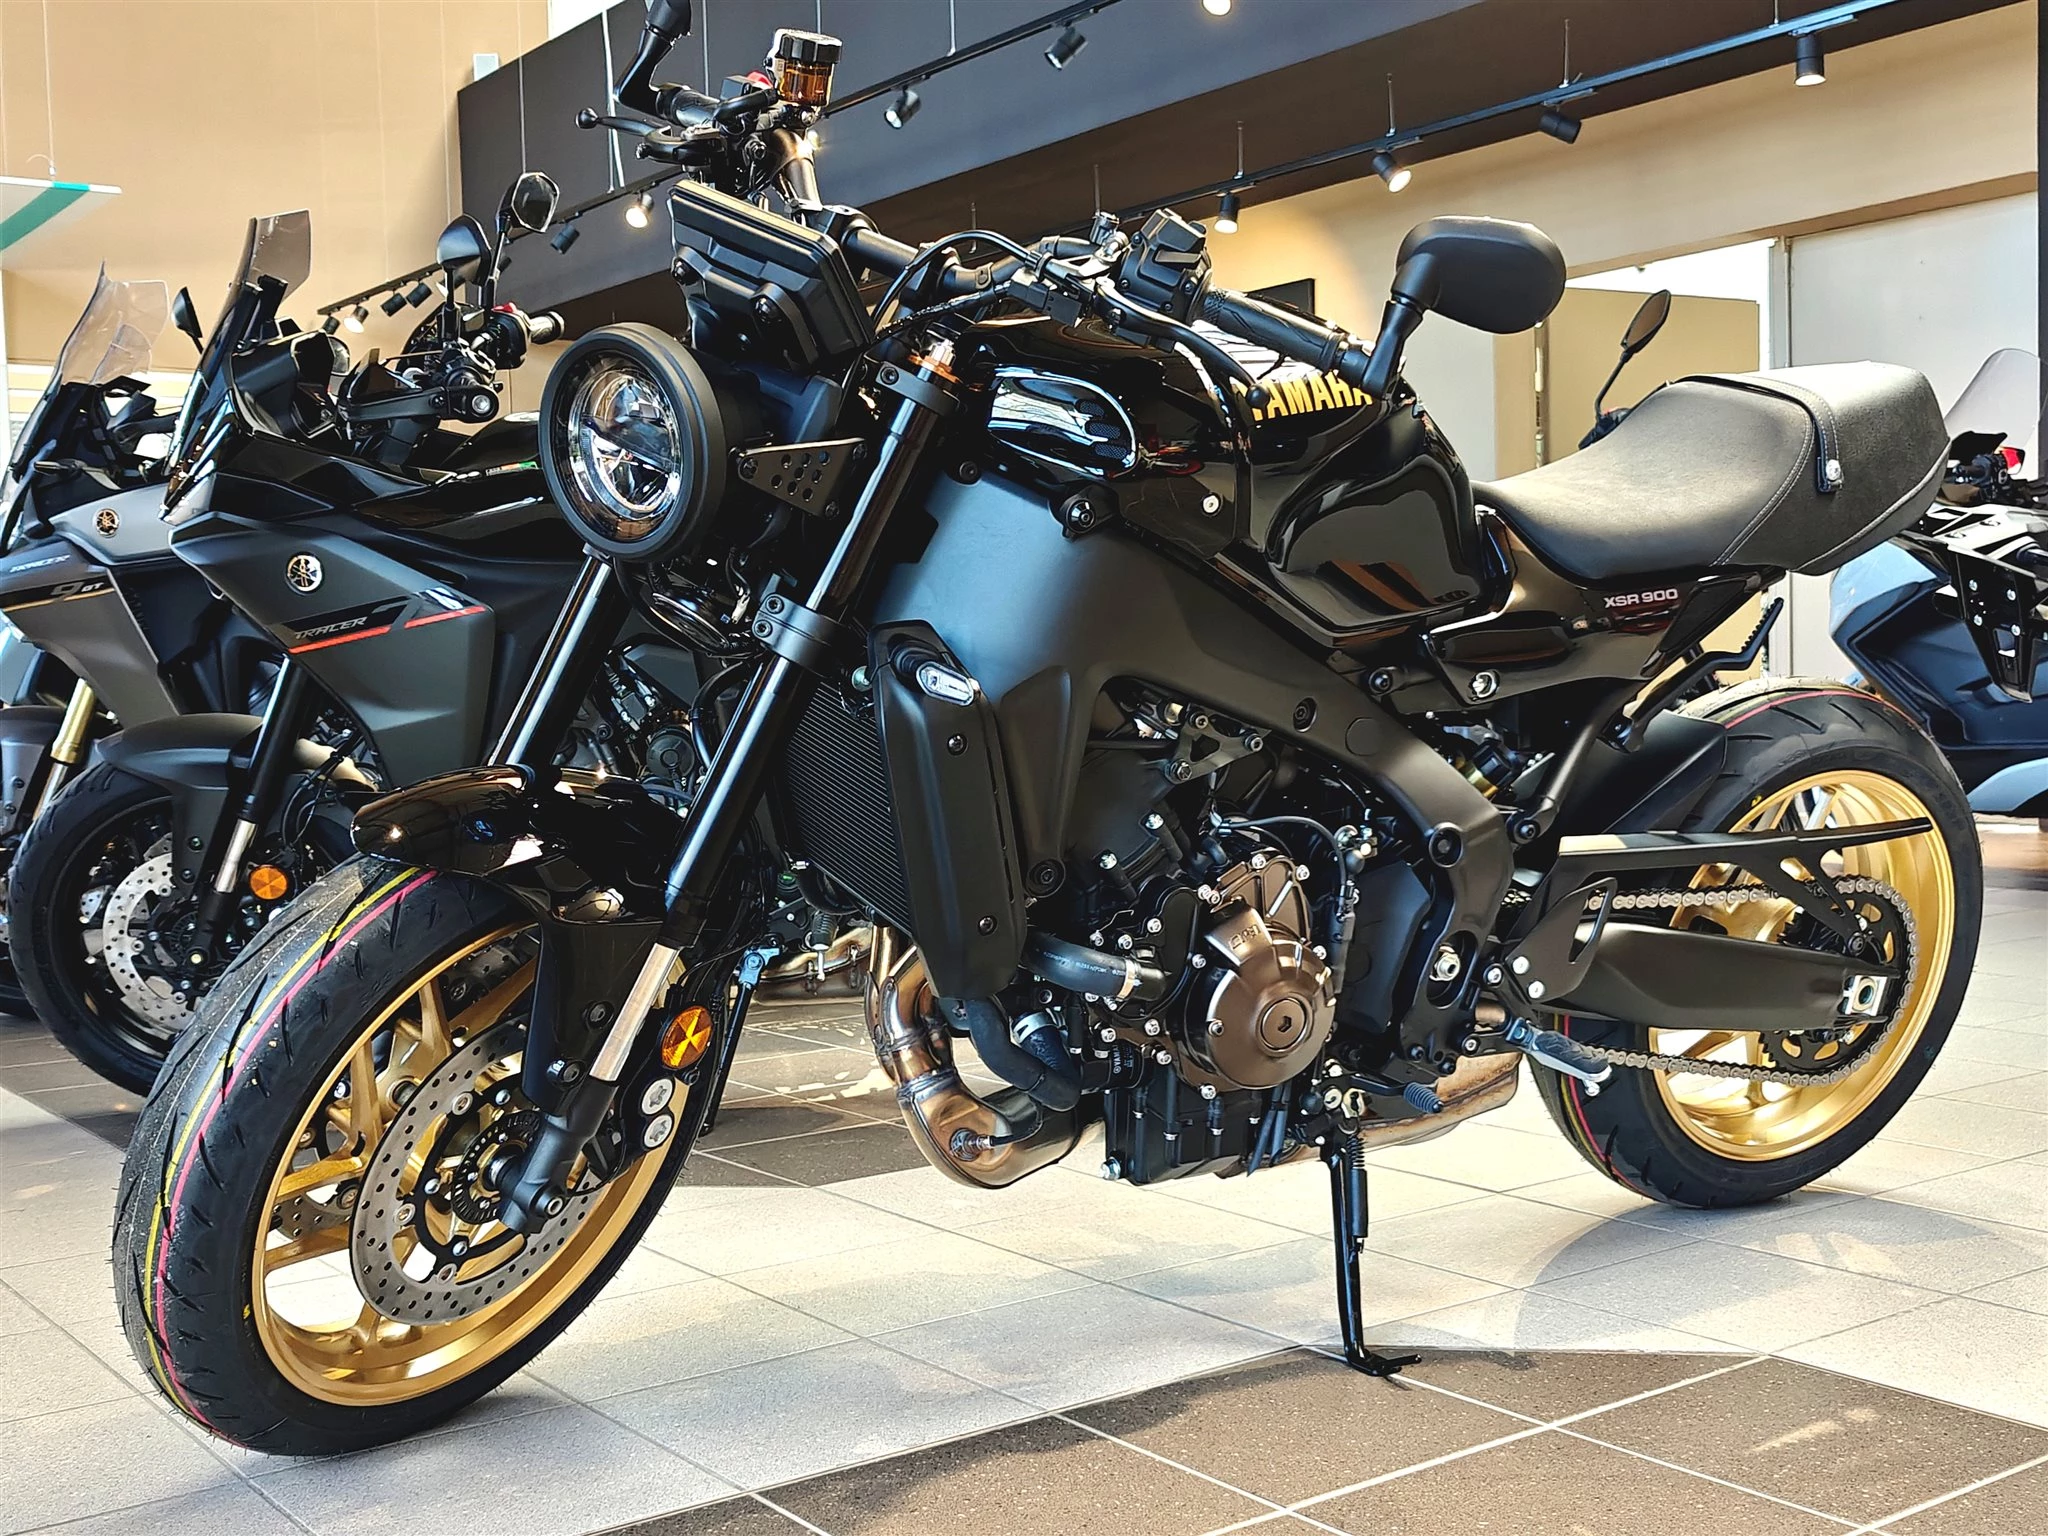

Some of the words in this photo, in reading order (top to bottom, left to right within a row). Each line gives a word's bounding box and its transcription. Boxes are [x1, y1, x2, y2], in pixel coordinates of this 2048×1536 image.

[1604, 594, 1640, 609] XSR
[1641, 588, 1679, 603] 900
[295, 616, 368, 640] TRACER
